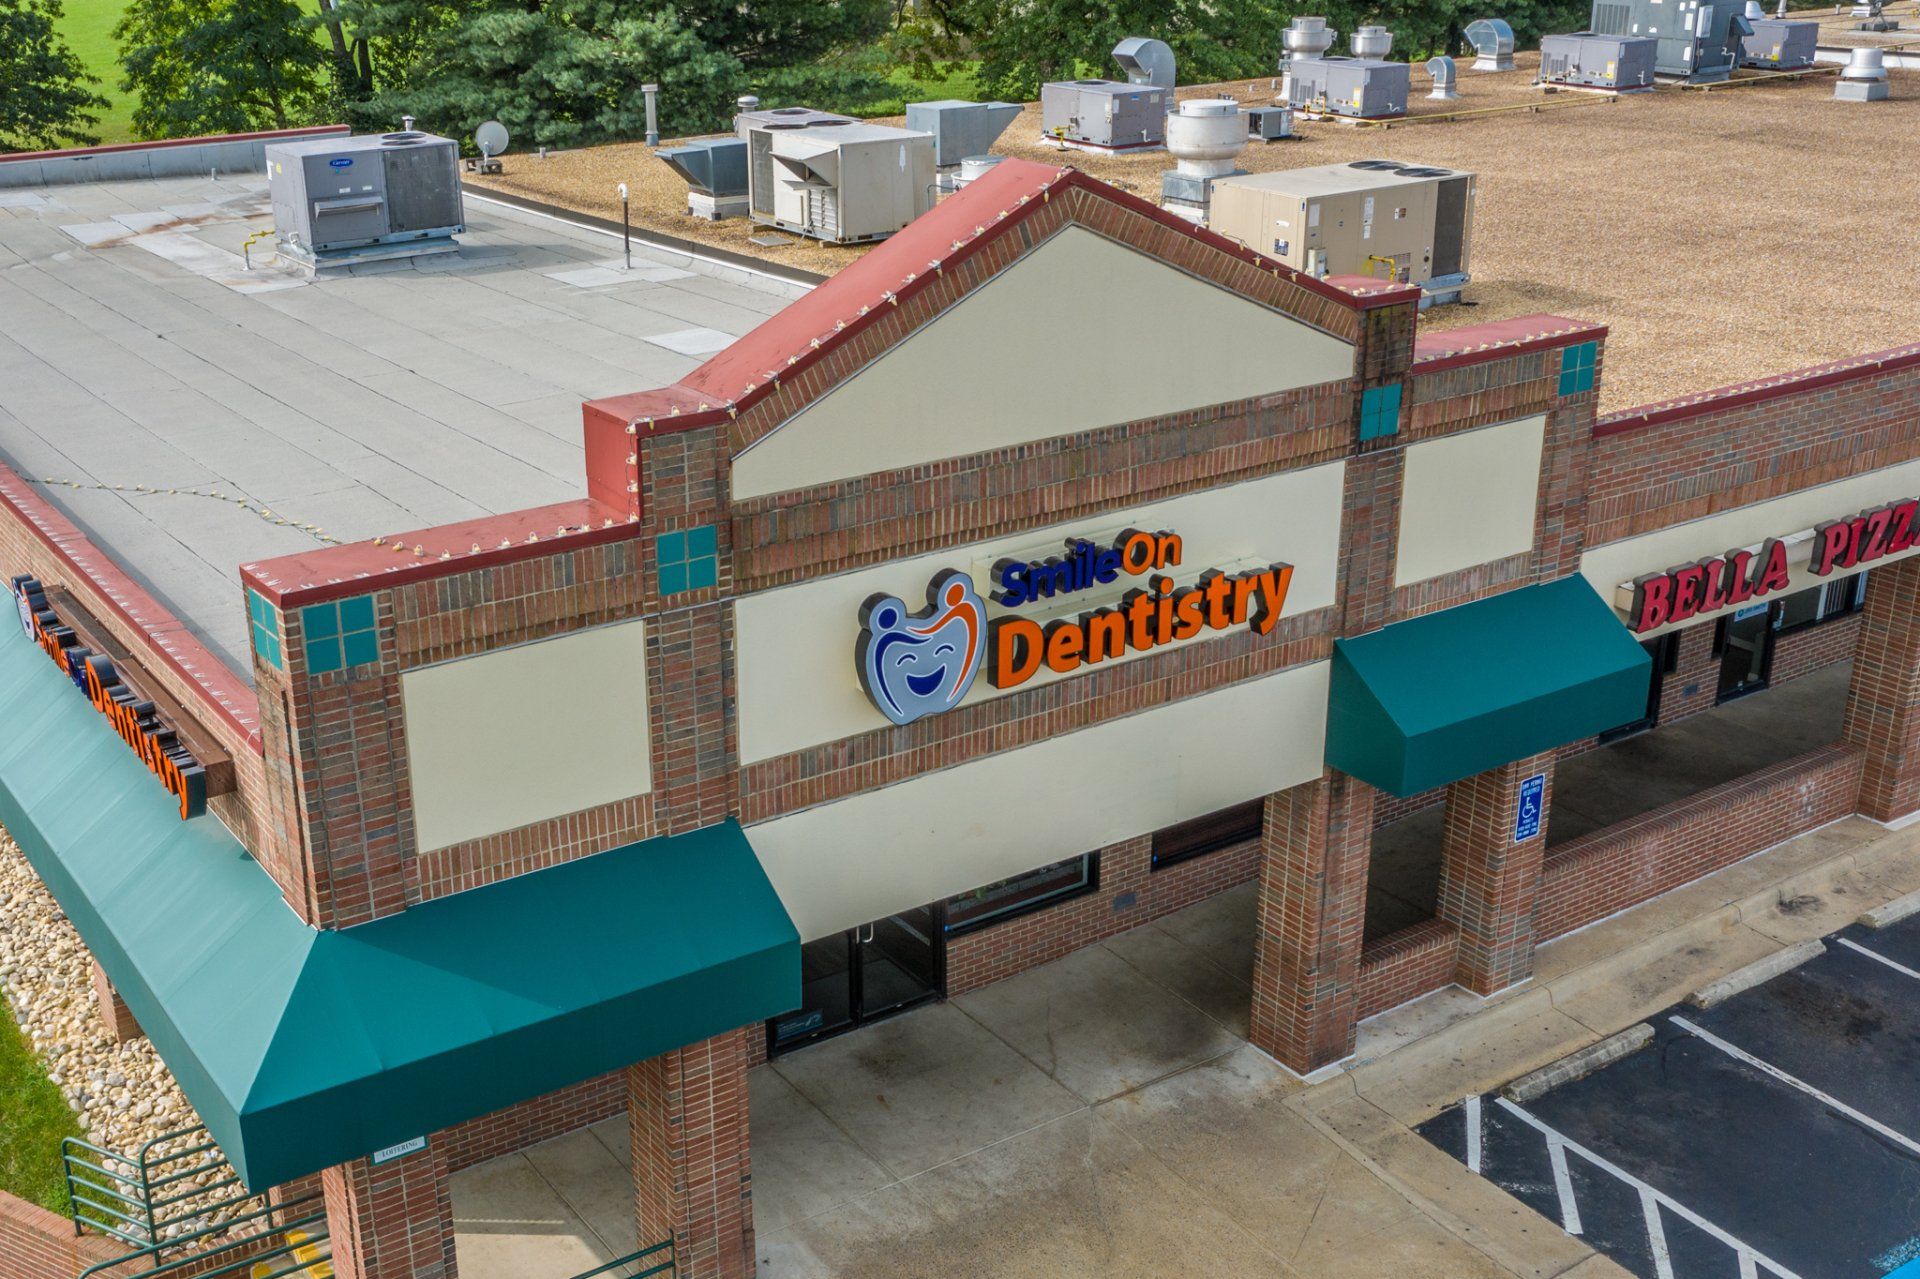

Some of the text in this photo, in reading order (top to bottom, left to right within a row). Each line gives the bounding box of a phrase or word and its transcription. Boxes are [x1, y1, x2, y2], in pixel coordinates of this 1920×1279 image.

[990, 562, 1294, 689] Dentistry
[1629, 498, 1920, 634] BELLA PIZZ
